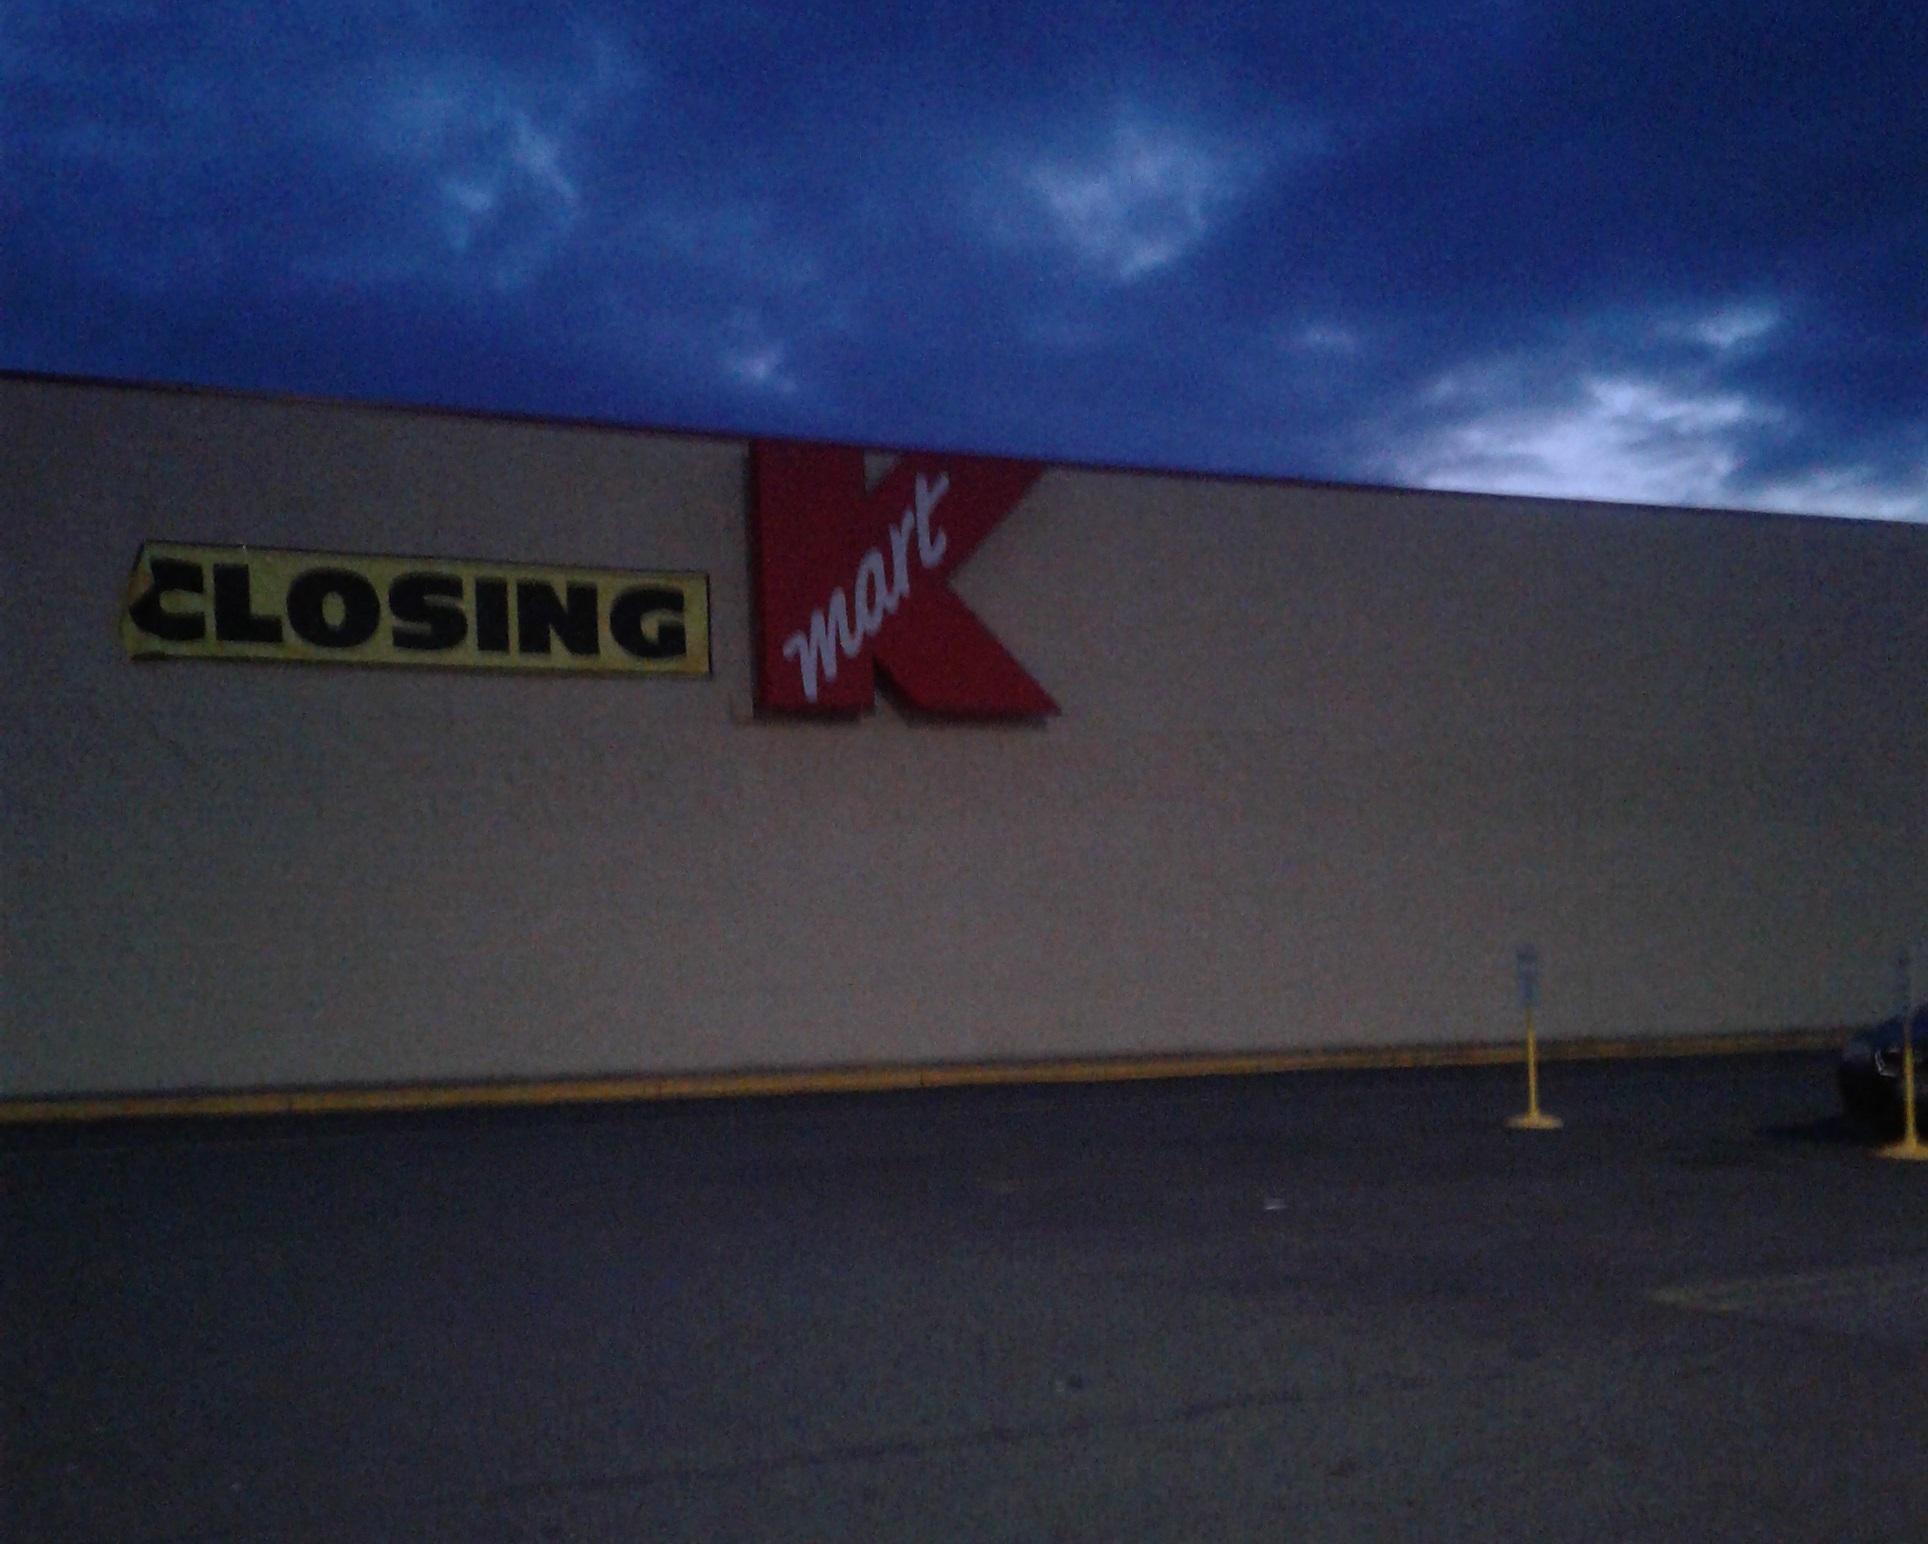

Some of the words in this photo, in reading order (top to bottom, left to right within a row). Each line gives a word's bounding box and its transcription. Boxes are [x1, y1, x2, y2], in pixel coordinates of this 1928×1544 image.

[129, 557, 687, 659] CLOSING
[753, 438, 1061, 718] K
[782, 471, 950, 703] mart
